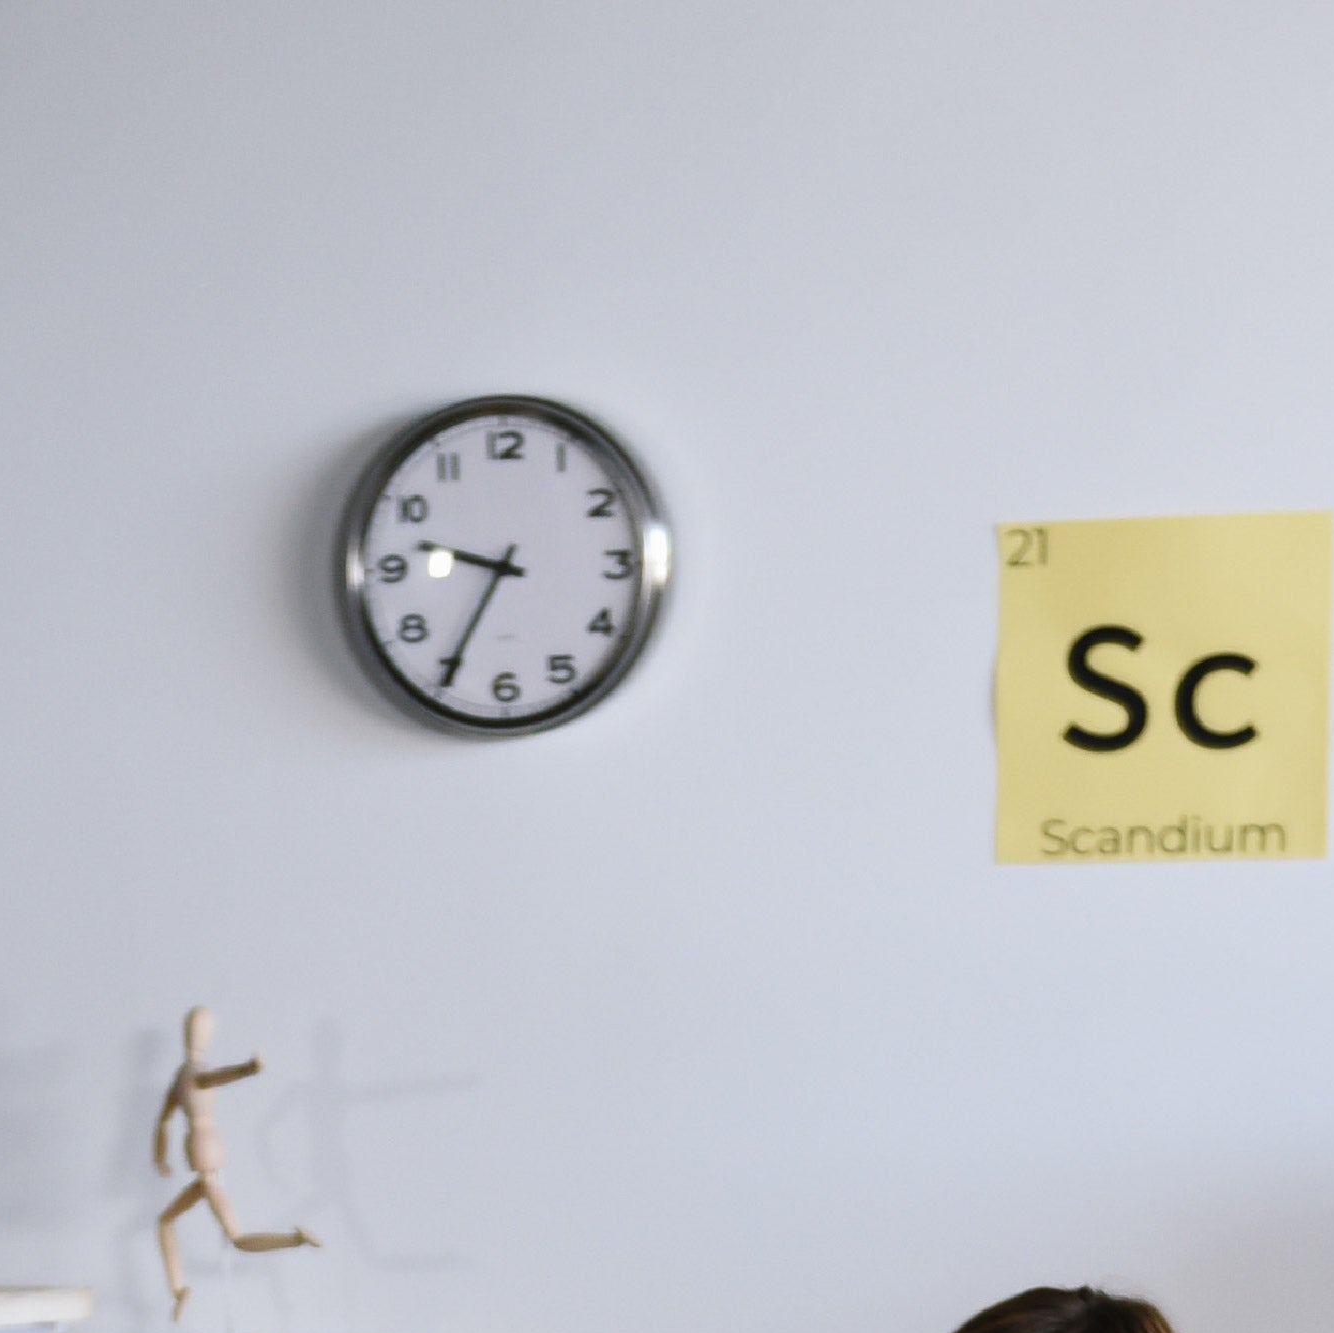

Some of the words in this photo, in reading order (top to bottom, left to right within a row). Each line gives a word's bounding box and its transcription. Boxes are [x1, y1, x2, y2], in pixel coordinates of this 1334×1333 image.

[486, 431, 524, 460] 12
[556, 444, 566, 472] 1
[437, 453, 460, 481] 11
[397, 495, 428, 523] 10
[587, 489, 615, 518] 2
[1004, 527, 1049, 567] 21
[379, 555, 407, 583] 9
[604, 549, 630, 580] 3
[400, 614, 427, 643] 8
[588, 609, 614, 637] 4
[547, 655, 576, 684] 5
[493, 673, 520, 702] 6
[1062, 621, 1259, 753] Sc
[1039, 815, 1287, 857] Scandium
